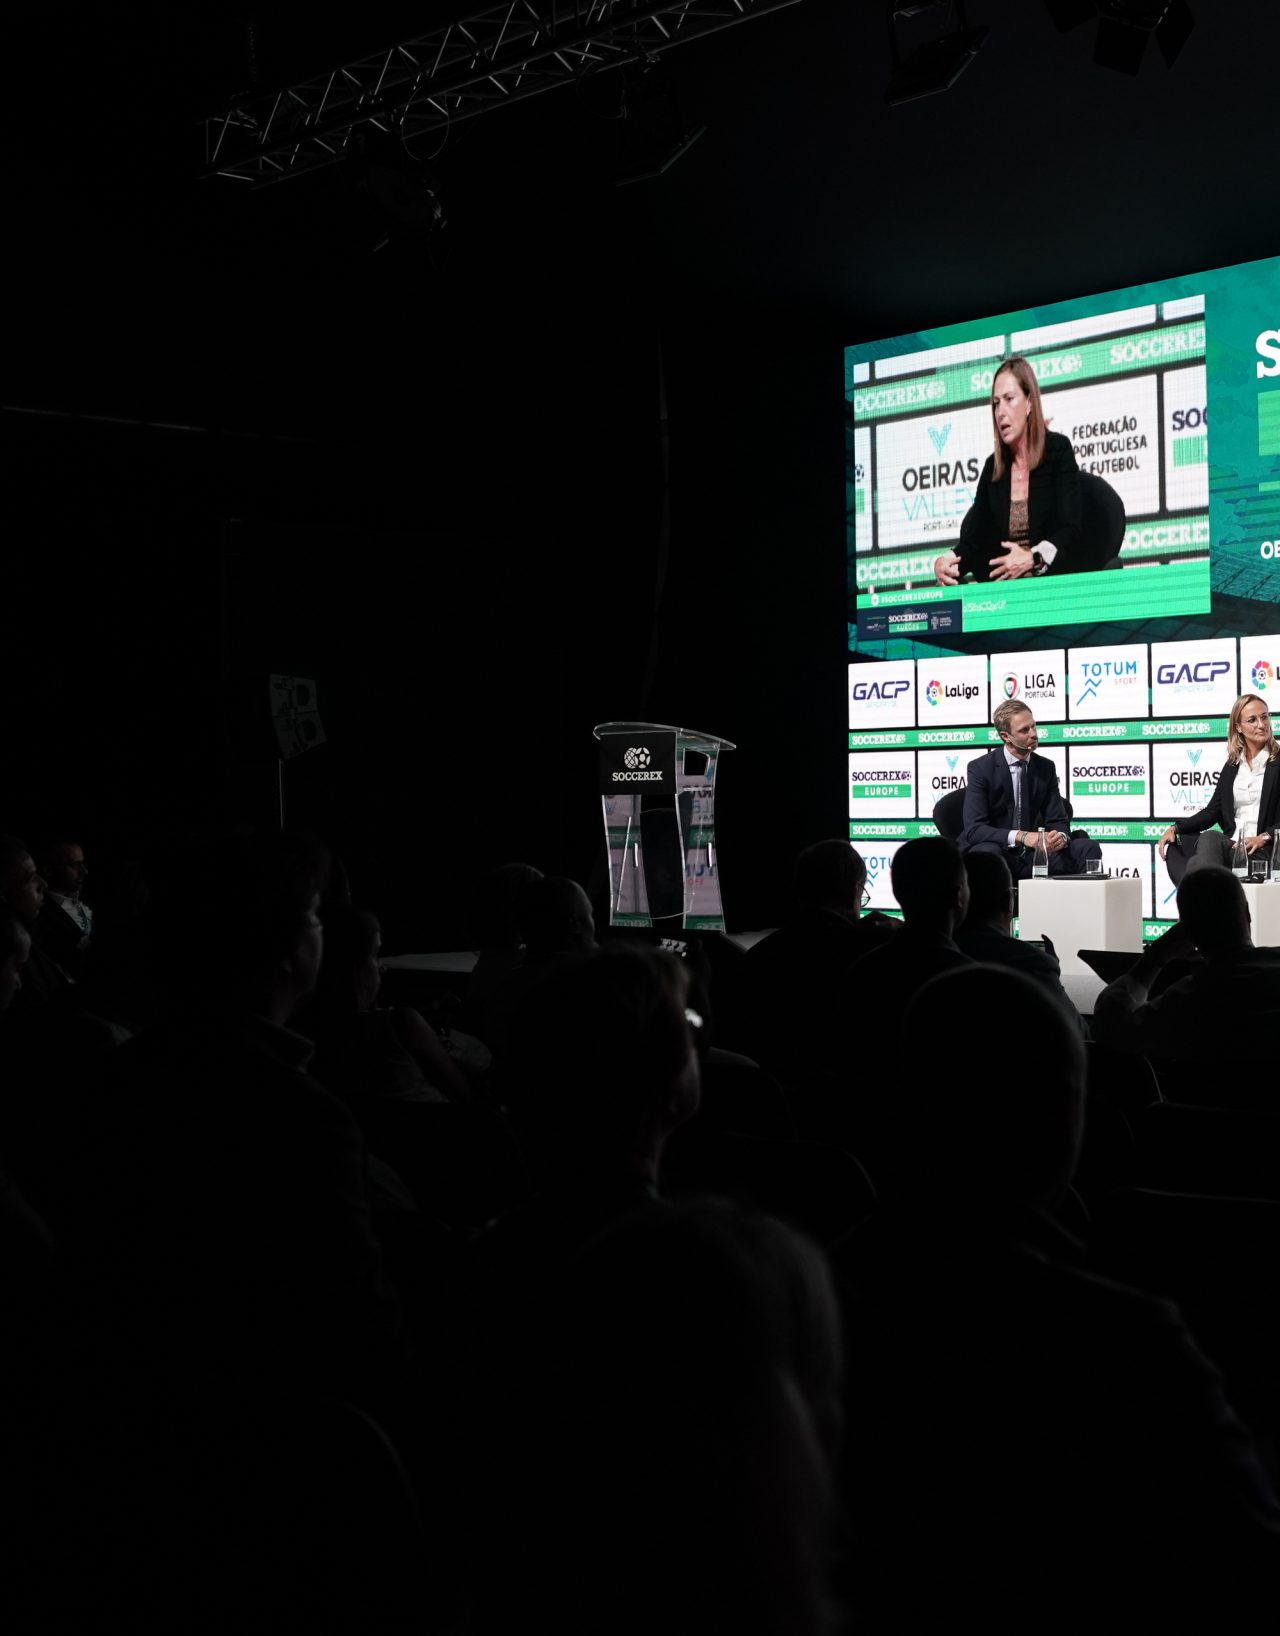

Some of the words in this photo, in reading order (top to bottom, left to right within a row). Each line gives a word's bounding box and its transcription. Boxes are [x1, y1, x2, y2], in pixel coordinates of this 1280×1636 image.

[1111, 331, 1205, 364] SOCCERE
[854, 387, 927, 411] OCCEREX
[1073, 416, 1138, 440] FEDERAÇÃO
[1073, 436, 1148, 457] PORTUGUESA
[1090, 455, 1140, 474] FUTEBOL
[902, 458, 979, 491] OEIRAS
[1122, 523, 1209, 550] OCCERE
[857, 555, 931, 581] OCCEREX
[888, 613, 922, 623] SOCCEREX
[1081, 661, 1137, 677] TOTUM
[1157, 661, 1231, 684] GACP
[1025, 673, 1056, 689] LIGA
[853, 680, 910, 701] GACP
[945, 683, 979, 699] LaLiga
[1025, 690, 1056, 699] PORTUGAL
[1062, 726, 1115, 738] SOCCEREX
[1142, 723, 1197, 735] SOCCEREX
[852, 733, 898, 745] SOCCEREX
[918, 732, 964, 743] SOCCEREX
[612, 771, 663, 781] SOCCEREX
[852, 771, 901, 782] SOCCEREX
[1073, 765, 1132, 777] SOCCEREX
[932, 776, 967, 790] OEIRA
[1088, 783, 1129, 793] EUROPE
[864, 787, 899, 795] EUROPE
[1170, 789, 1212, 804] VALLE
[853, 825, 897, 836] SOCCEREX
